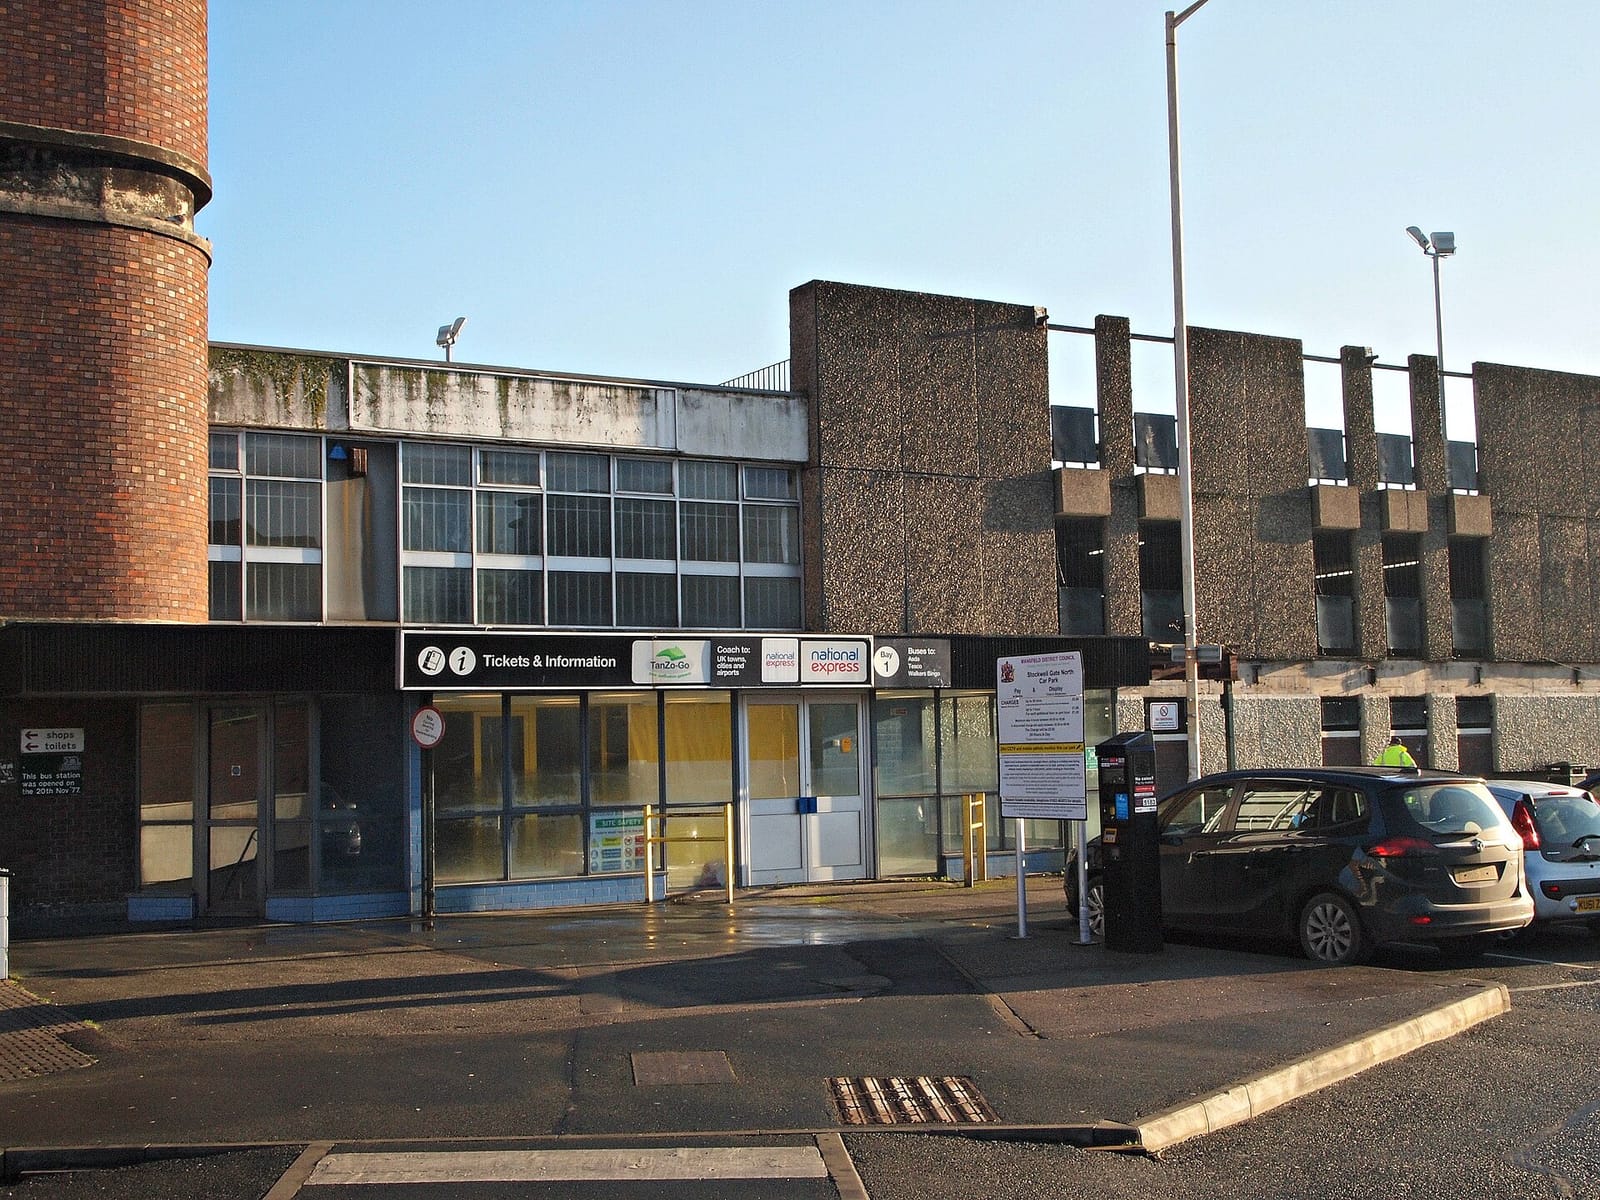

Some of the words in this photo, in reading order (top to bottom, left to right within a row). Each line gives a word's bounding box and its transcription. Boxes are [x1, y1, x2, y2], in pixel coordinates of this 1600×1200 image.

[716, 646, 740, 654] Coach
[741, 646, 751, 654] to:
[908, 647, 927, 655] Buses
[927, 647, 936, 655] to:
[766, 652, 794, 660] national
[811, 648, 859, 661] national
[880, 651, 894, 660] Bay
[482, 654, 530, 668] Tickets
[532, 654, 542, 668] &
[545, 655, 616, 668] Information
[727, 656, 747, 664] towns,
[766, 660, 795, 668] express
[811, 662, 860, 675] express
[884, 661, 889, 672] 1
[46, 732, 74, 740] shops
